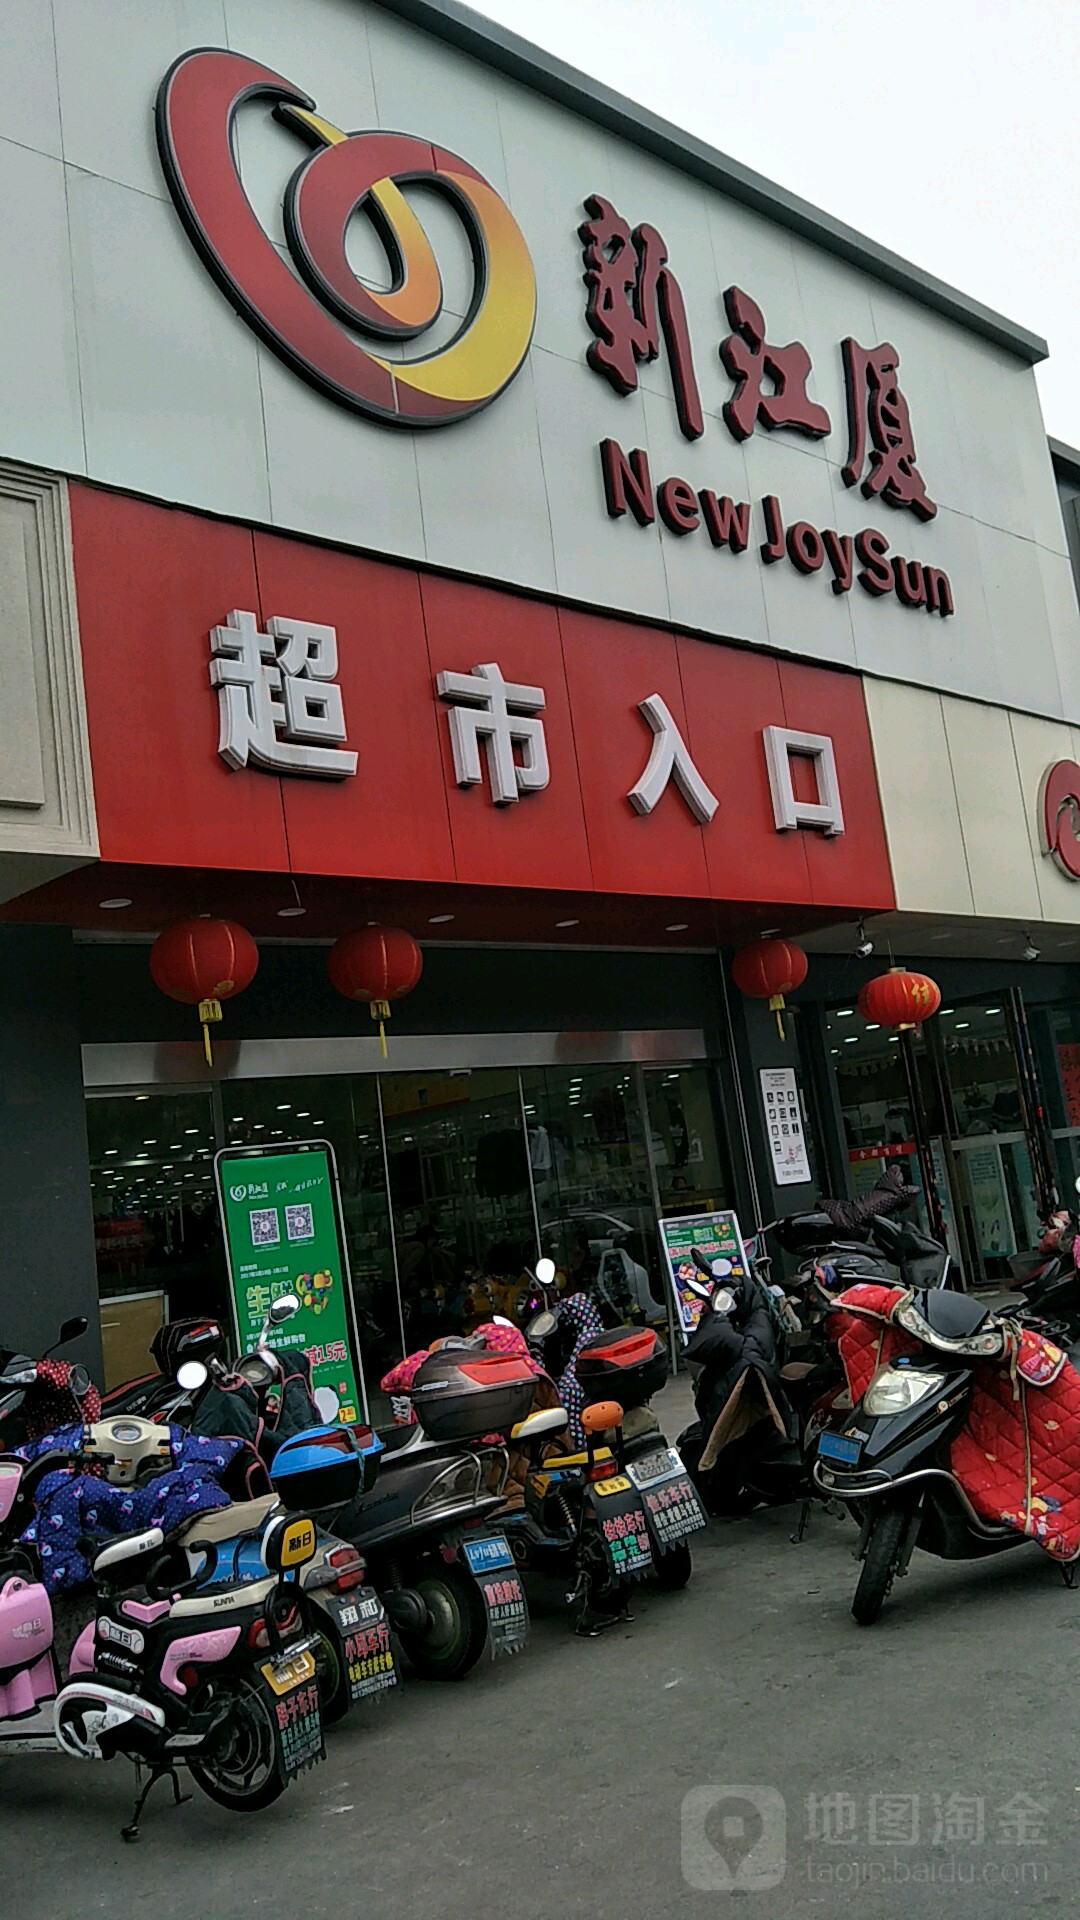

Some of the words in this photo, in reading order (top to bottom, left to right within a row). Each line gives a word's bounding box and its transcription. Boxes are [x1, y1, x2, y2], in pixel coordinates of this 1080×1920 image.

[209, 608, 846, 838] 超市入口
[289, 1530, 312, 1552] 新日
